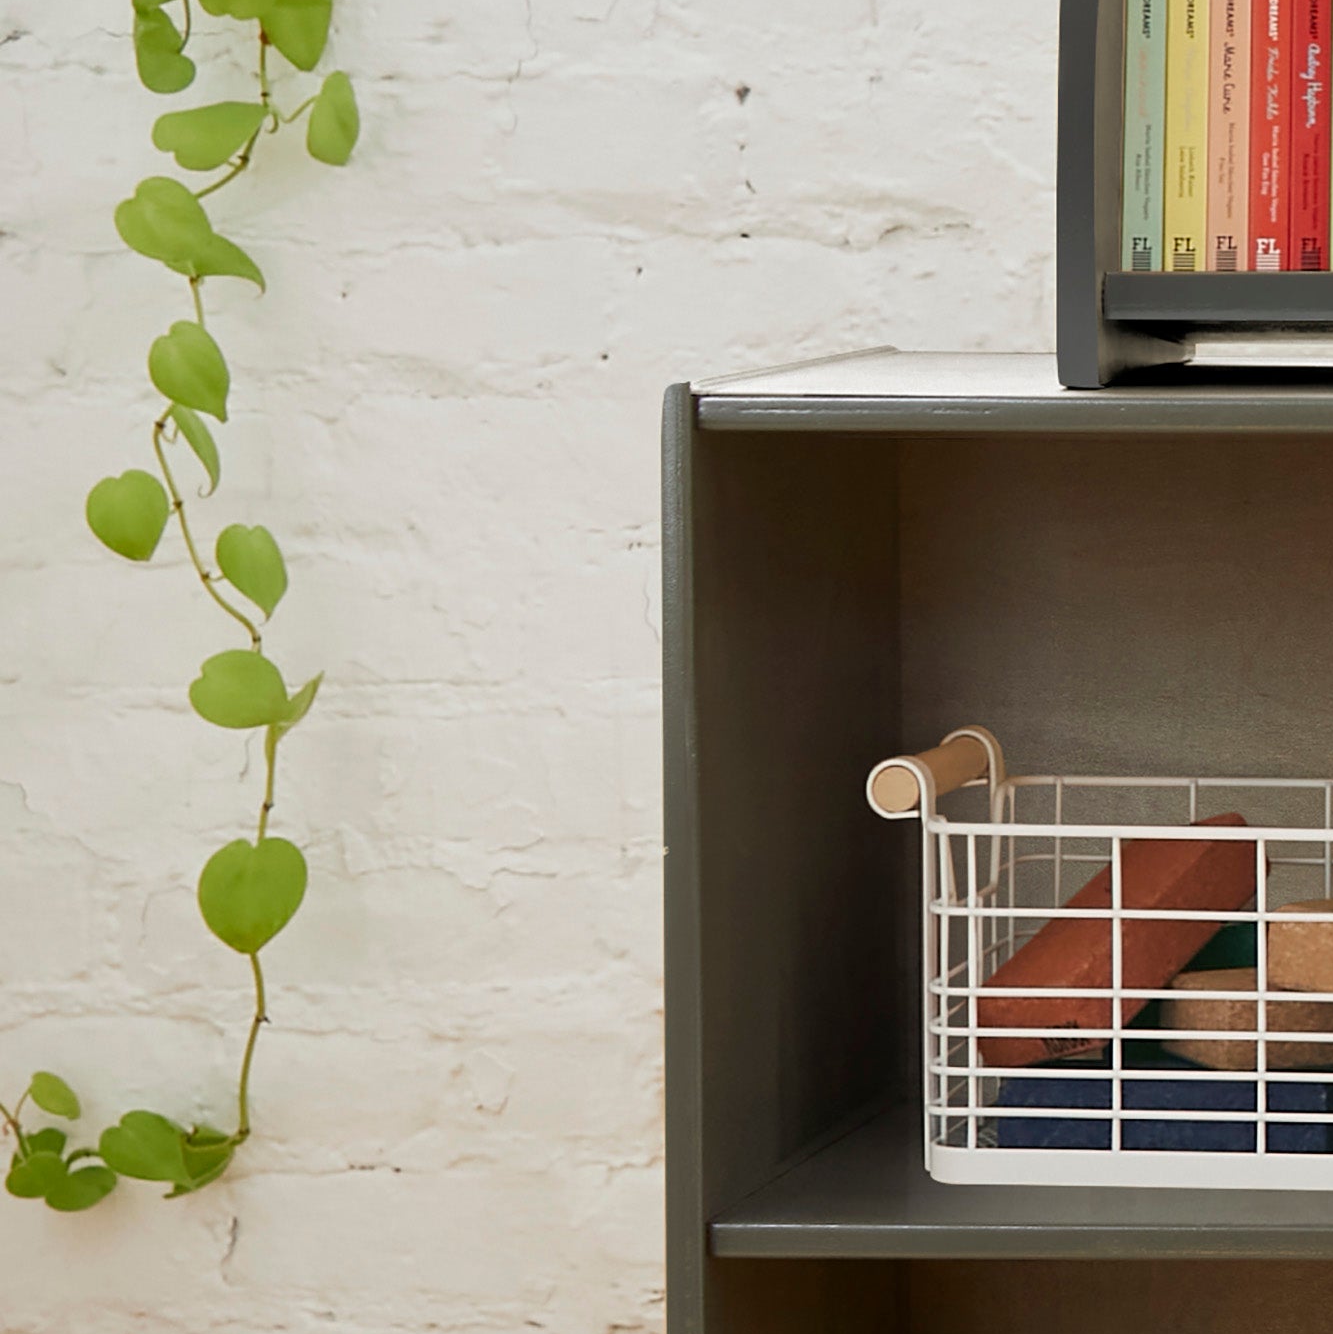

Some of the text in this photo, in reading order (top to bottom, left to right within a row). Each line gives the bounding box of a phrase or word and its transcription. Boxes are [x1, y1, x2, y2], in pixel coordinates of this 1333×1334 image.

[1224, 42, 1235, 79] Marie
[1267, 47, 1279, 81] Frida
[1300, 43, 1320, 79] Audrey
[1223, 83, 1234, 113] Curie
[1133, 237, 1152, 250] FL
[1174, 237, 1196, 251] FL
[1217, 236, 1237, 249] FL
[1256, 238, 1280, 254] FL
